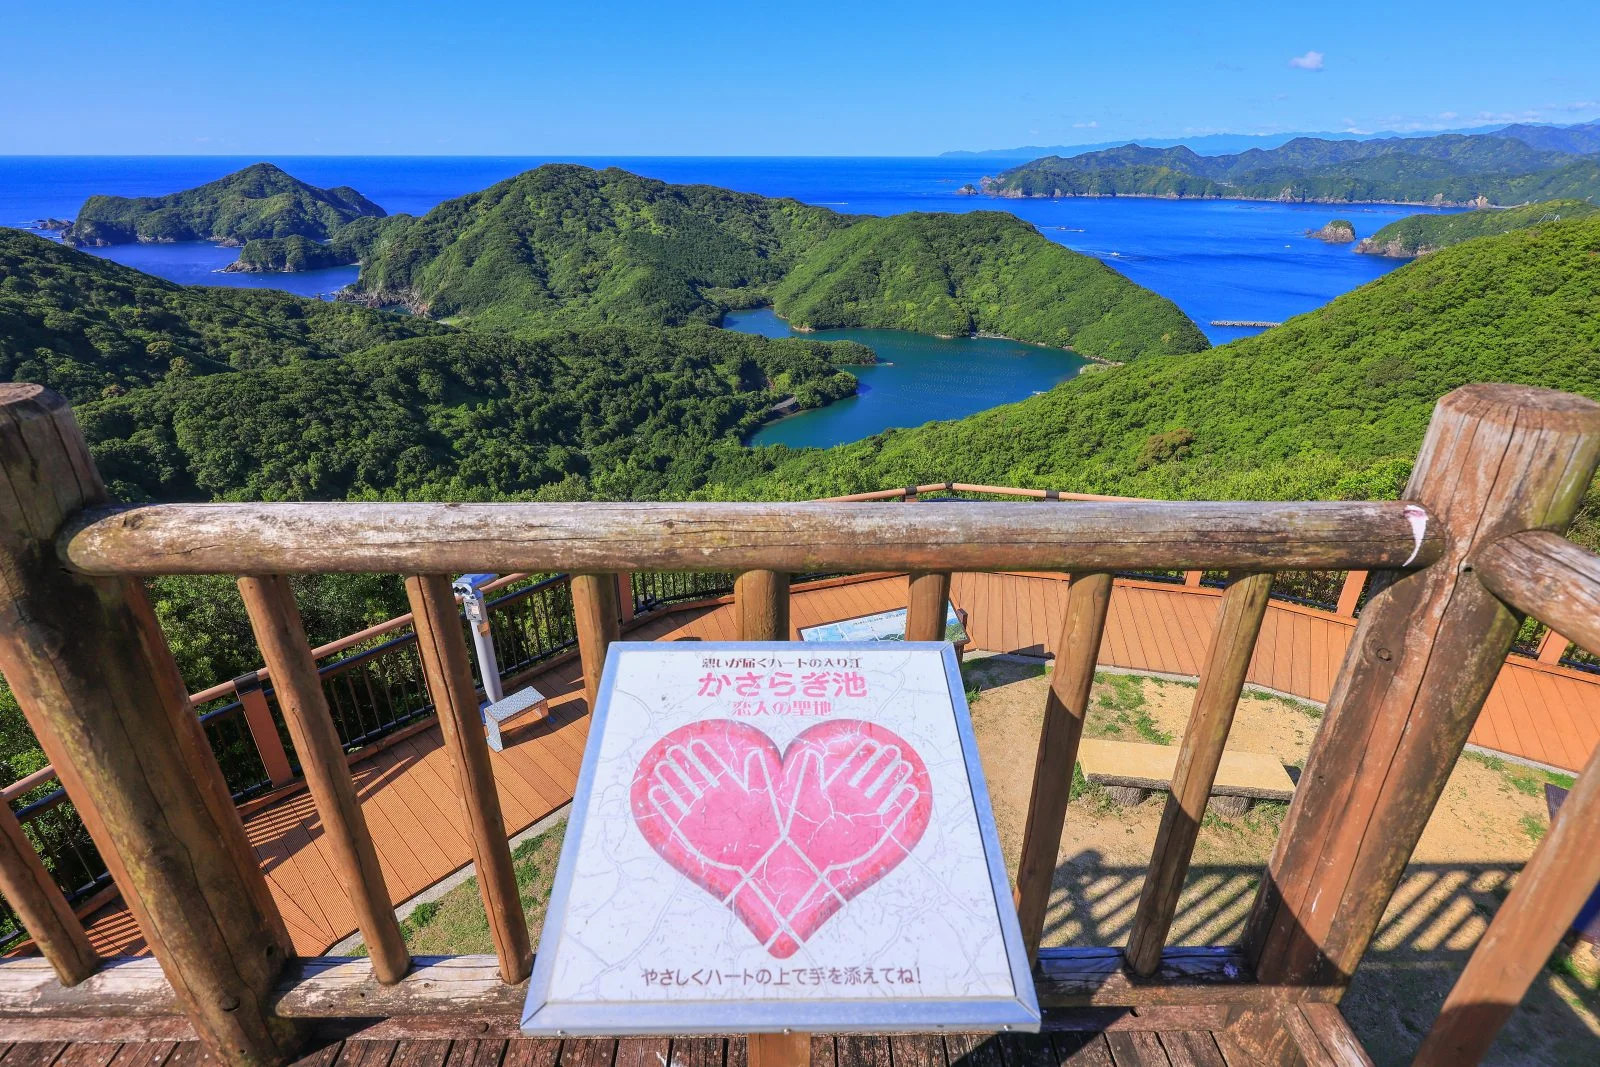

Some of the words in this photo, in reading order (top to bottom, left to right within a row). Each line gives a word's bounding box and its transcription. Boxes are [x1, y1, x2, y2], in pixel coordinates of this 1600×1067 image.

[697, 671, 868, 698] かさらぎ池
[733, 700, 832, 716] 恋人の聖地
